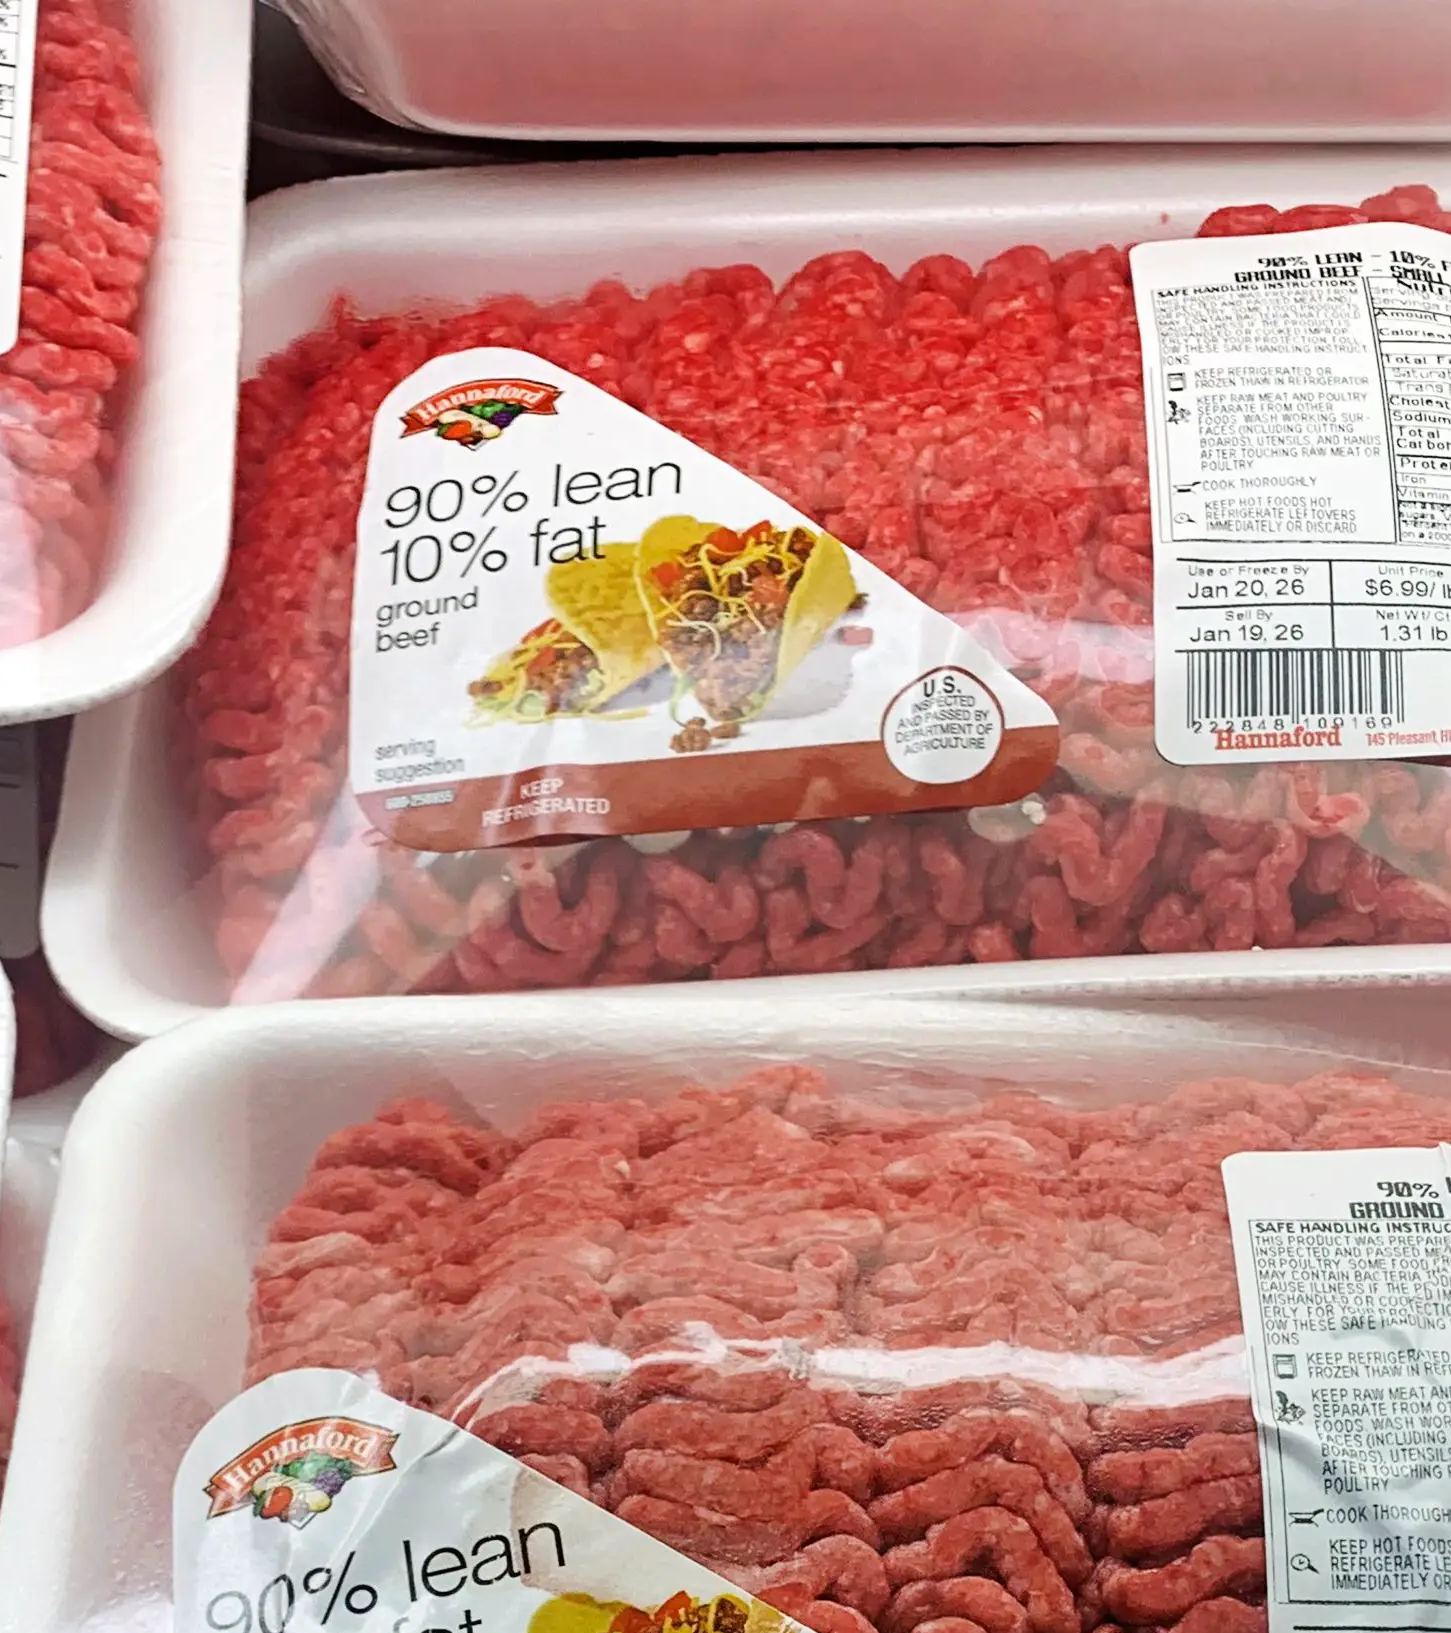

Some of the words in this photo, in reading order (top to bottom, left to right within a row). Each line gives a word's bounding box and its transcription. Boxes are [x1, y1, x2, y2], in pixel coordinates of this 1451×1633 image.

[417, 382, 543, 422] Hannaford
[384, 470, 530, 531] 90%
[552, 461, 684, 508] lean
[379, 527, 509, 587] 10%
[532, 515, 607, 566] fat
[1187, 580, 1231, 599] Jan
[1276, 579, 1306, 596] 26
[1365, 578, 1439, 599] $6.99/
[376, 587, 479, 628] ground
[376, 625, 440, 654] beef
[1380, 625, 1423, 642] 1.31
[1429, 624, 1449, 641] lb
[922, 676, 963, 697] U.S.
[374, 737, 437, 761] serving
[1215, 728, 1341, 750] Hannaford
[374, 755, 466, 779] suggestion
[519, 778, 566, 799] KEEP
[481, 798, 611, 829] REFRIGERATED
[223, 1425, 382, 1494] Hannaford
[403, 1521, 568, 1607] lean
